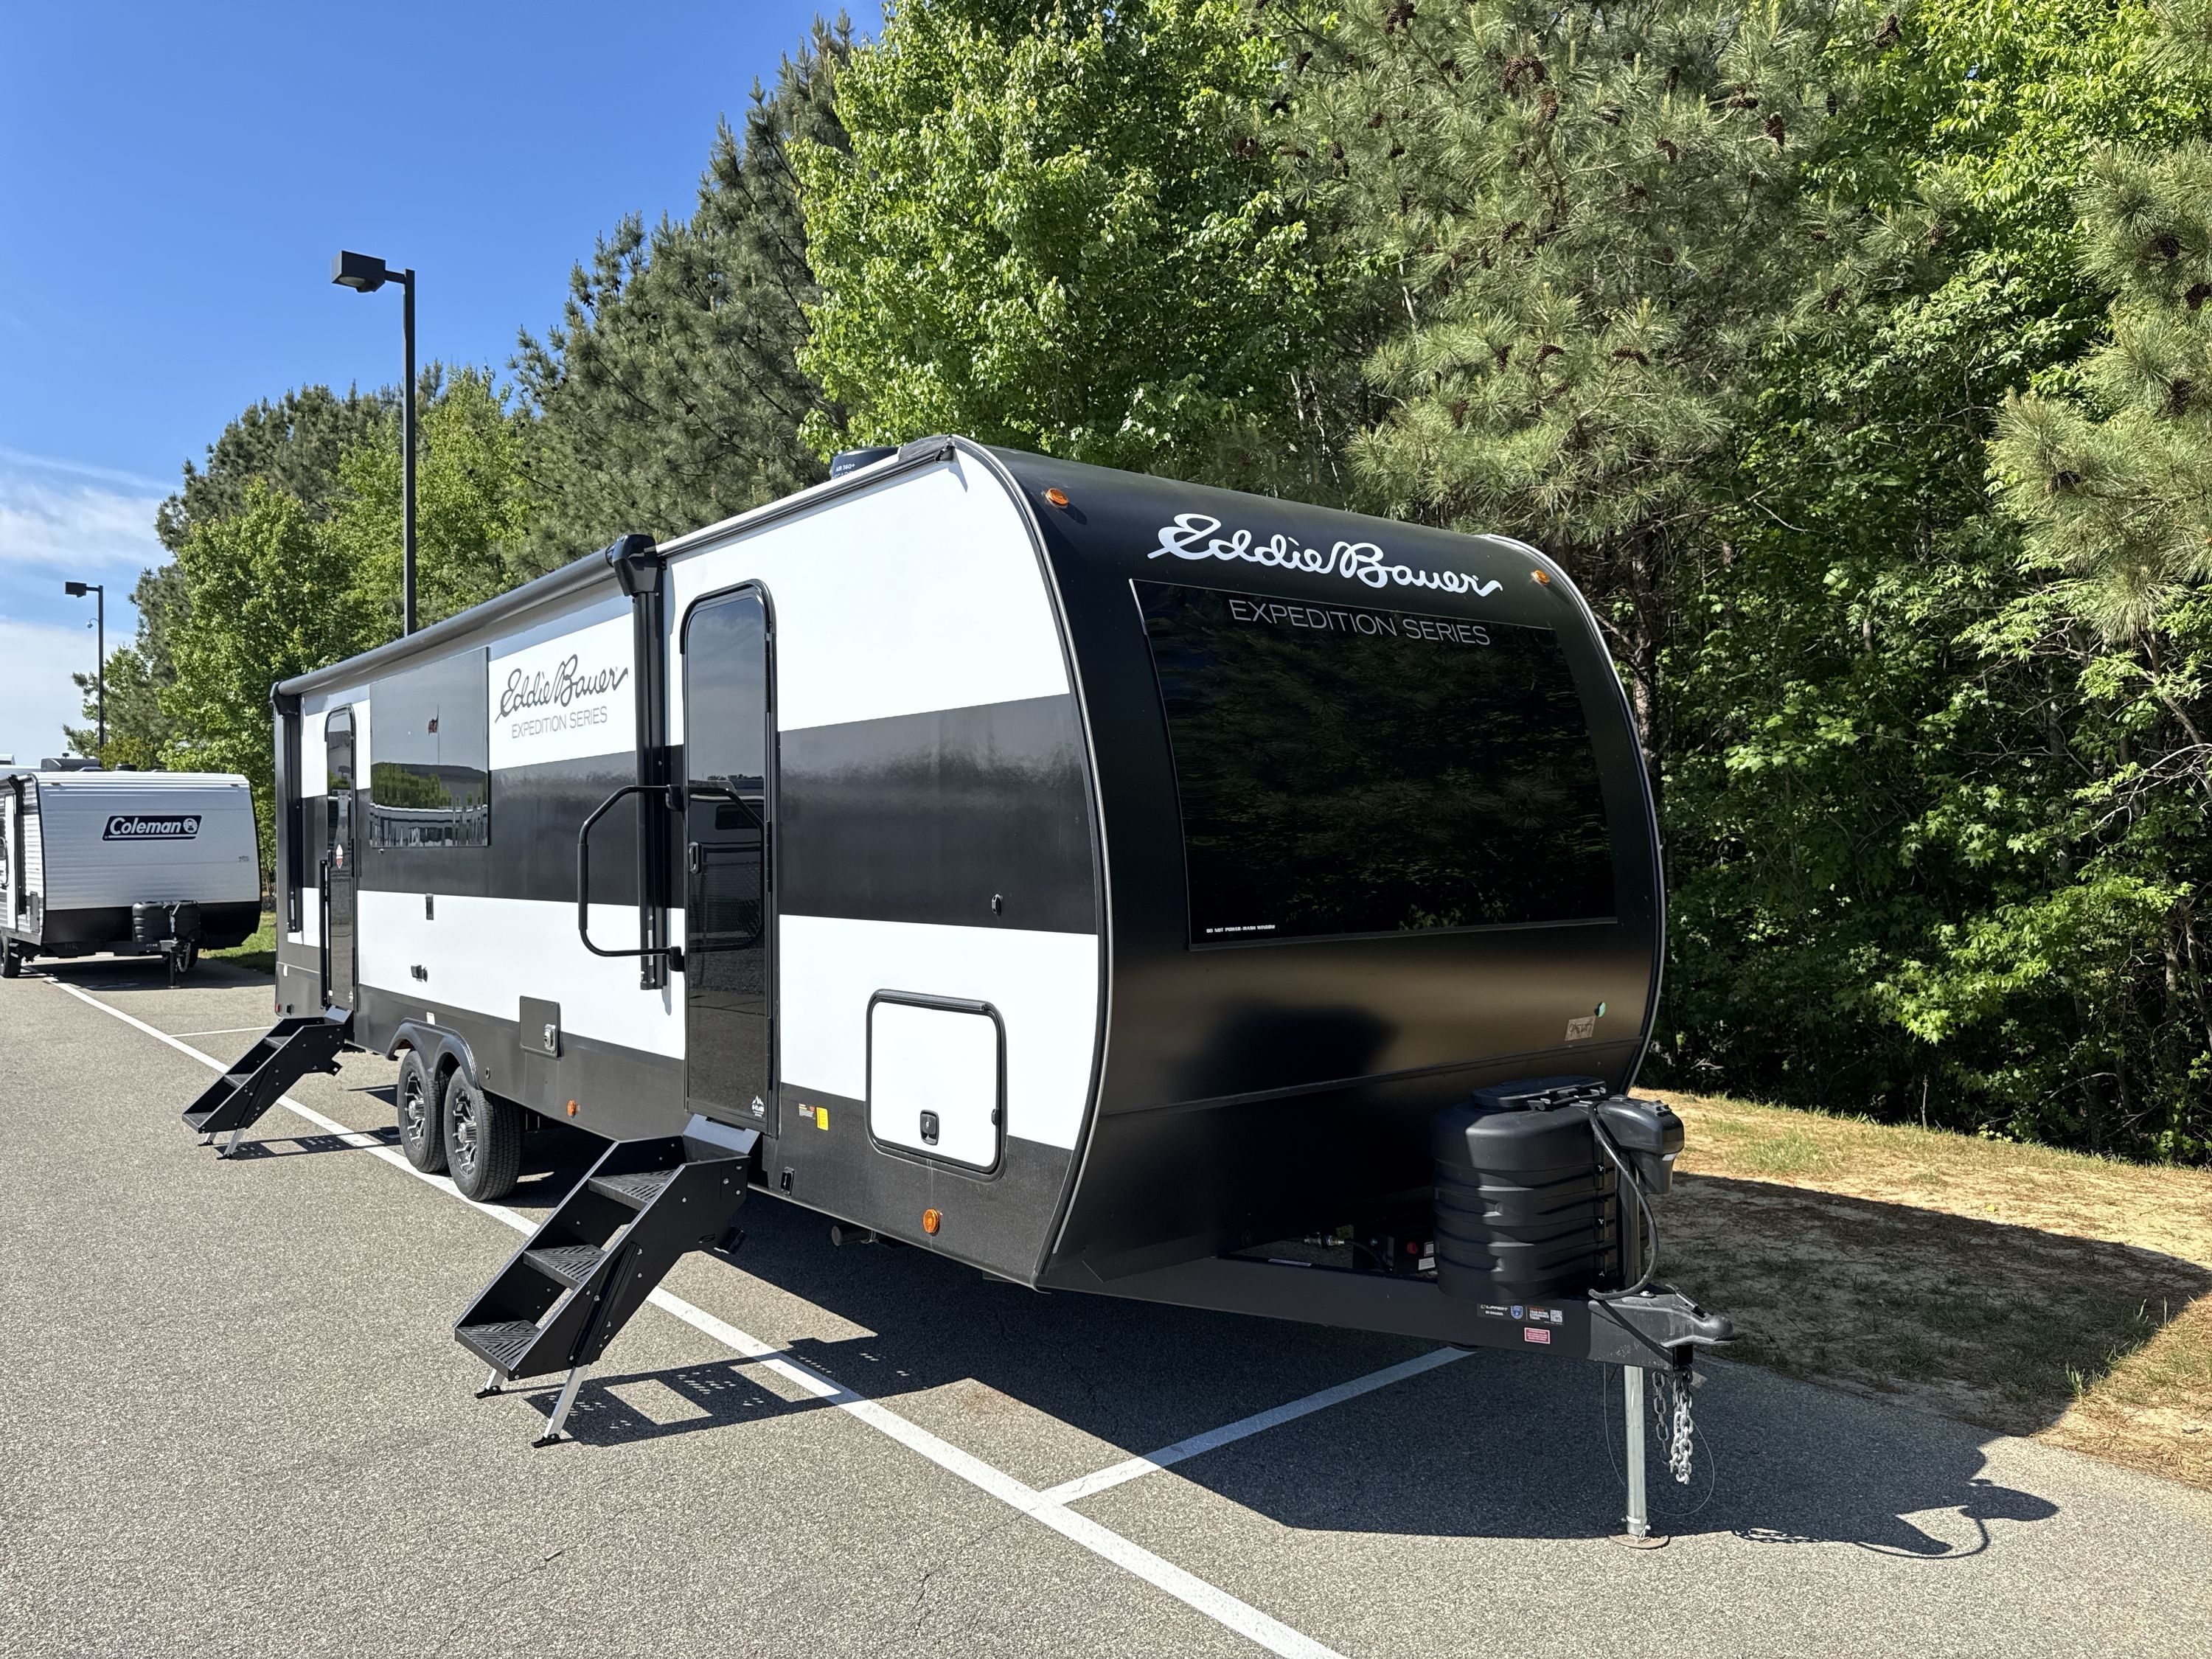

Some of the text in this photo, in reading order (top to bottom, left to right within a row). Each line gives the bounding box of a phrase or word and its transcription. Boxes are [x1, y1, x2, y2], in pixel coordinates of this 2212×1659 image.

[1147, 513, 1503, 597] Eddie Bauer
[1228, 599, 1490, 646] EXPEDITION SERIES
[494, 653, 629, 723] Eddie Bauer
[512, 706, 608, 739] EXPEDITION SERIES
[110, 817, 182, 835] Coleman
